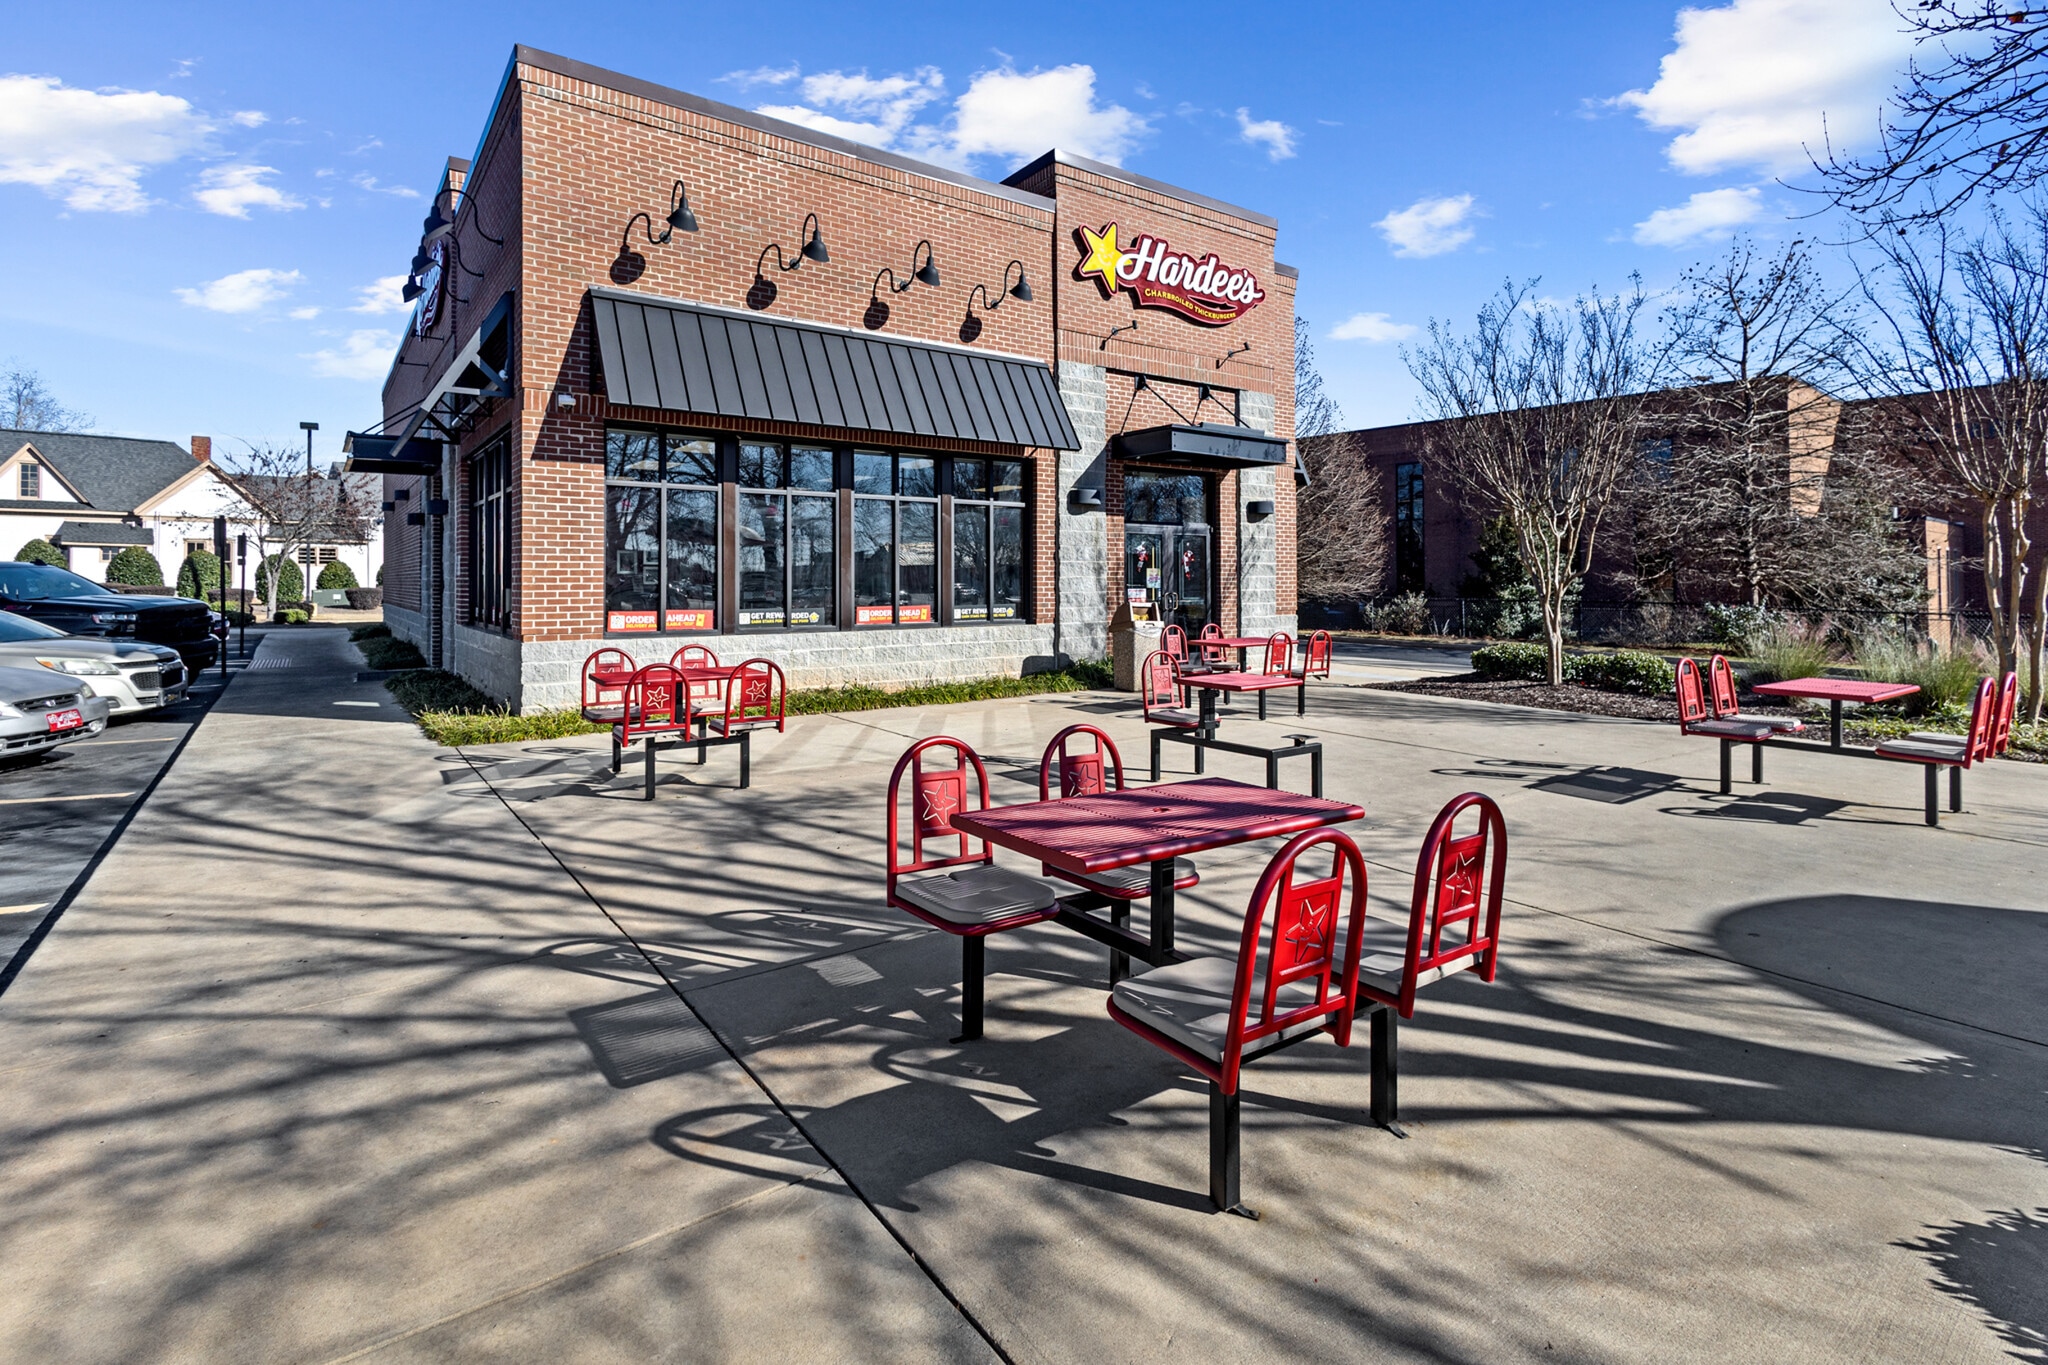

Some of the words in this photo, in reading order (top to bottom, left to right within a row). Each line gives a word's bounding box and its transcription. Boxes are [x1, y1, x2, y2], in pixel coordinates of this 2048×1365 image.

[1116, 236, 1263, 304] Hardee's
[1144, 288, 1194, 309] CHARBROILED
[1194, 306, 1236, 319] THICKBURGERS
[625, 615, 655, 624] ORDER
[666, 613, 695, 622] AHEAD
